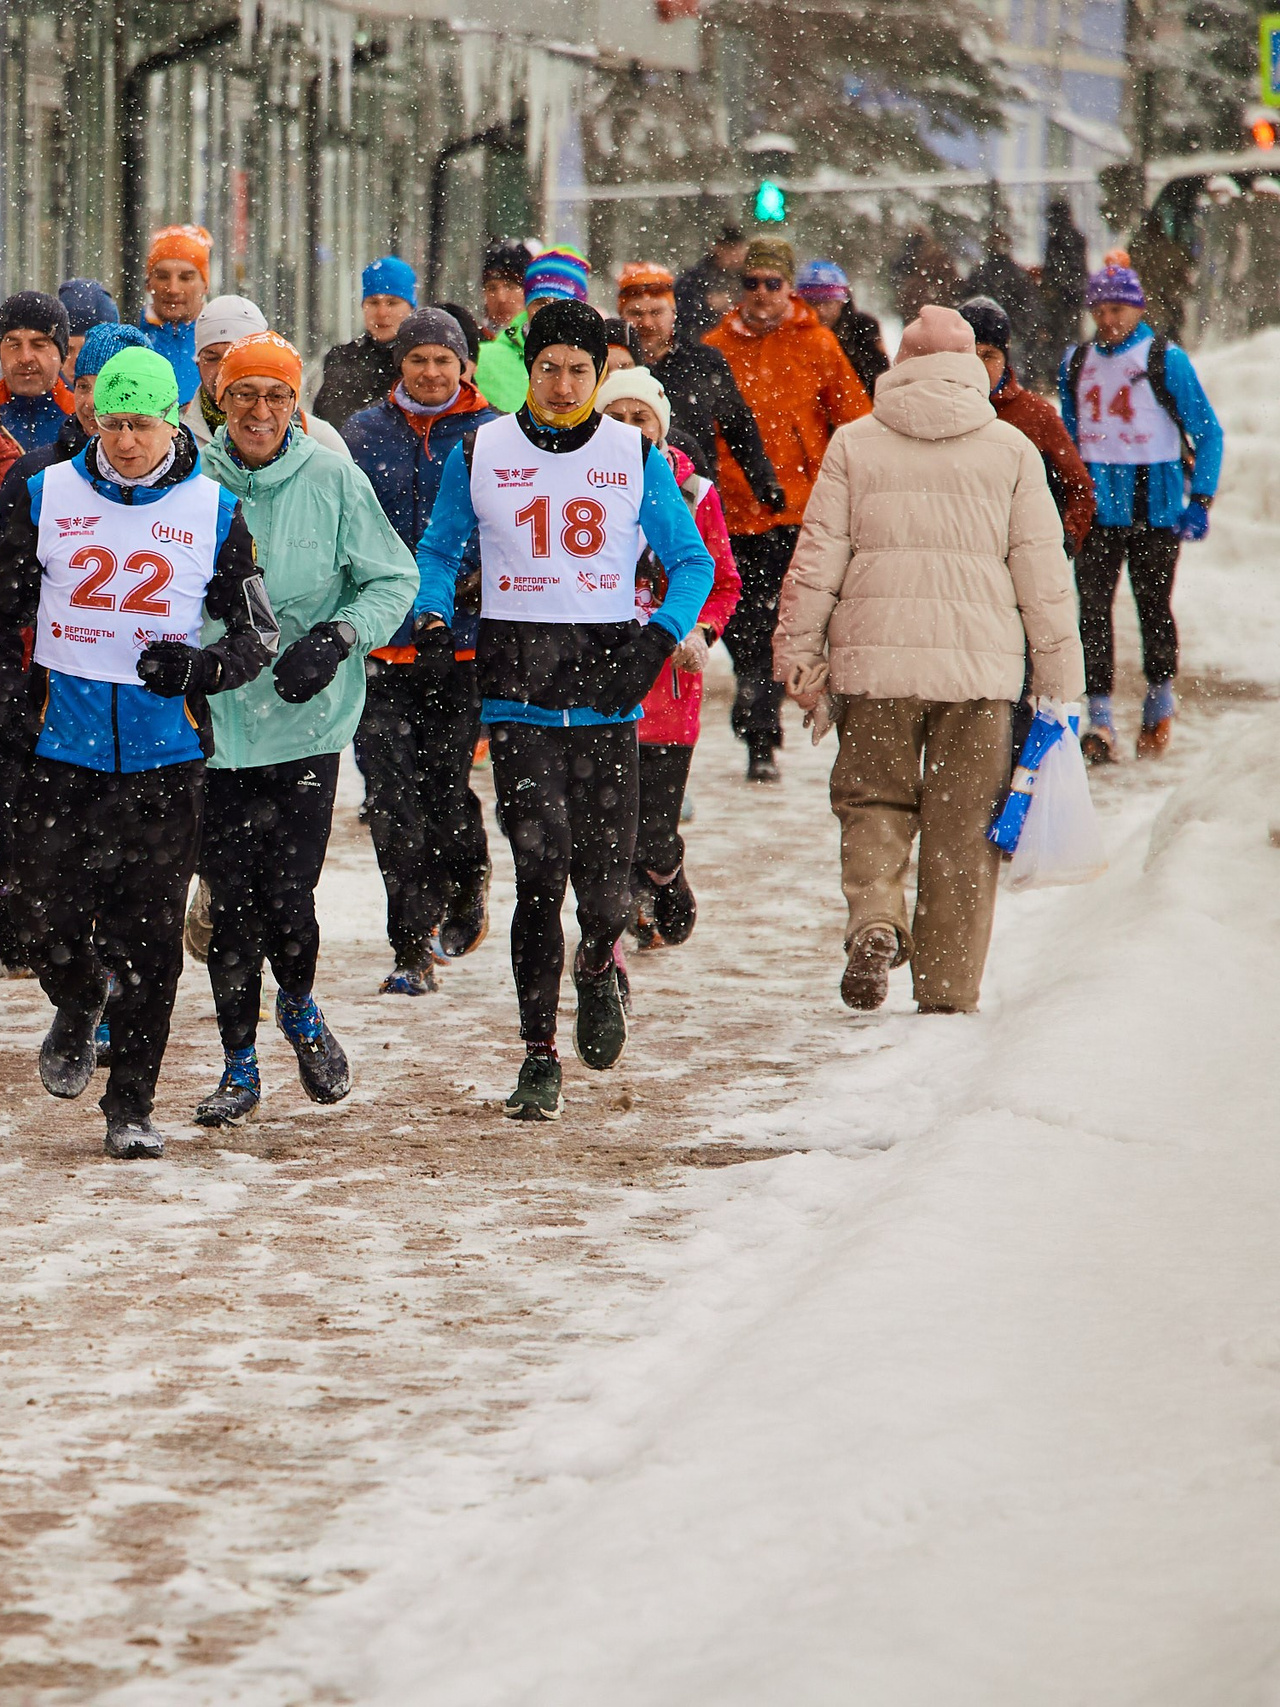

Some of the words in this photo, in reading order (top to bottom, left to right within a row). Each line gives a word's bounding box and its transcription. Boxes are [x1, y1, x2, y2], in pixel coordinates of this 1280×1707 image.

[1084, 385, 1135, 424] 14
[593, 471, 627, 486] НЦВ
[515, 495, 607, 559] 18
[158, 525, 193, 545] НЦВ
[69, 545, 174, 617] 22
[513, 576, 560, 584] ВЕРТОЛЕТЫ
[600, 582, 617, 590] НЦВ
[513, 584, 544, 592] РОССИИ
[64, 625, 115, 638] ВЕРТОЛЕТЫ
[64, 633, 97, 644] РОССИИ
[297, 780, 322, 788] DEMIX
